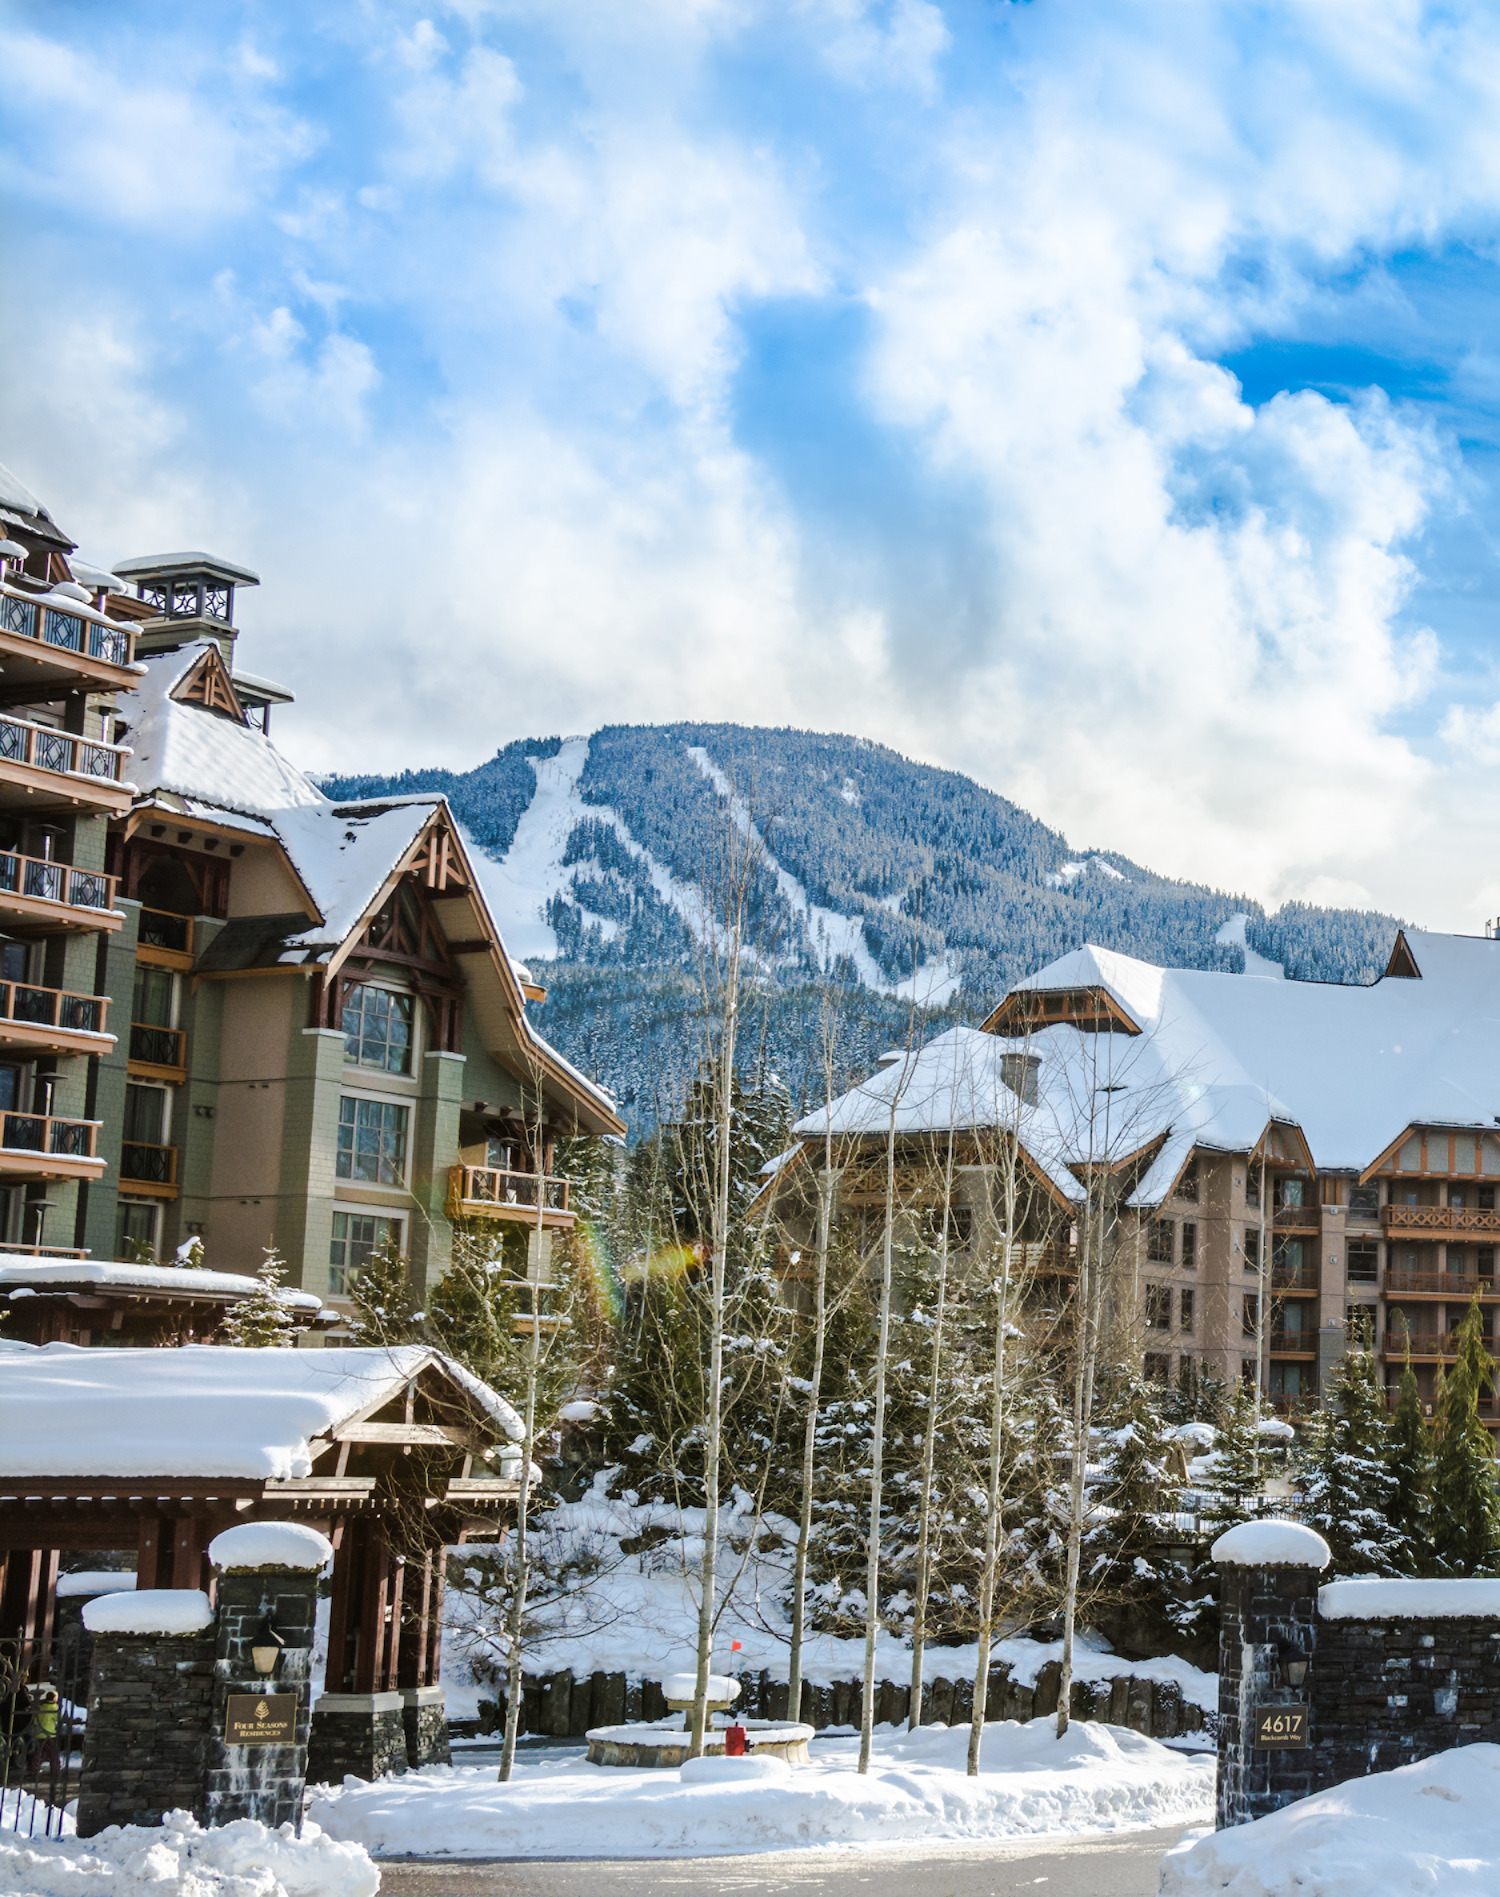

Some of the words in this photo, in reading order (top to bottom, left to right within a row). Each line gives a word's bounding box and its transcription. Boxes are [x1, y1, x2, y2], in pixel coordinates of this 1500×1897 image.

[234, 1721, 254, 1730] FOUR
[256, 1721, 288, 1729] SEASONS
[1261, 1715, 1302, 1733] 4617
